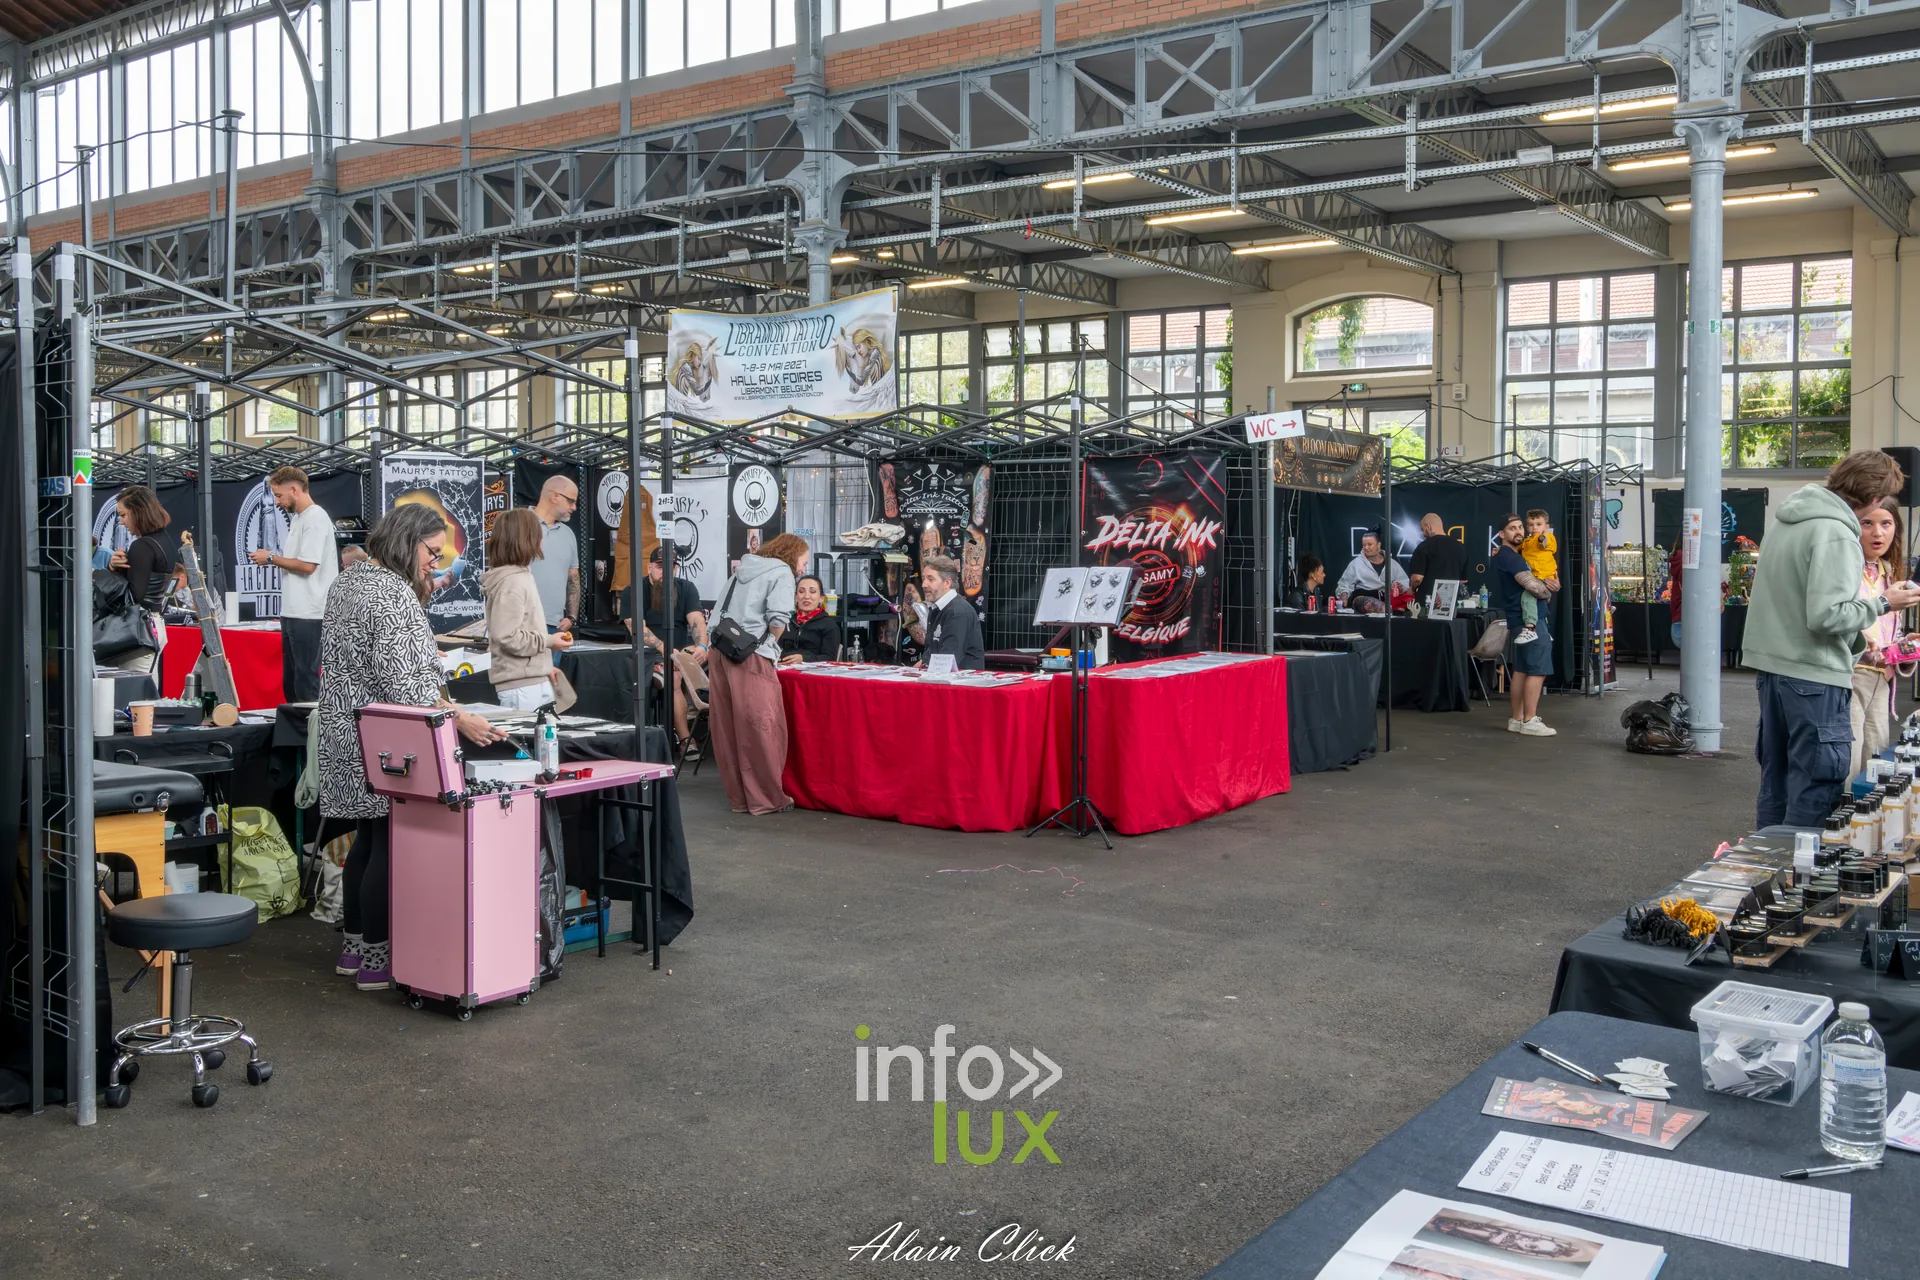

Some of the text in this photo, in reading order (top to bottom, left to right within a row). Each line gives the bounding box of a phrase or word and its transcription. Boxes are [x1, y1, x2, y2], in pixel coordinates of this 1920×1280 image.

[738, 340, 817, 357] CONVENTION
[741, 360, 807, 372] 7-8-9 MAI 2027
[730, 370, 823, 387] HALL AUX FOIRES
[740, 384, 813, 396] LIBRAMONT BELGIUM
[1250, 418, 1277, 438] WC
[392, 466, 474, 477] MAURY'S TATTOO
[1085, 515, 1222, 553] DELTA INK
[1479, 1156, 1501, 1177] Grande
[1535, 1174, 1548, 1185] Best
[1548, 1159, 1560, 1170] day
[1557, 1163, 1583, 1192] Réalisme
